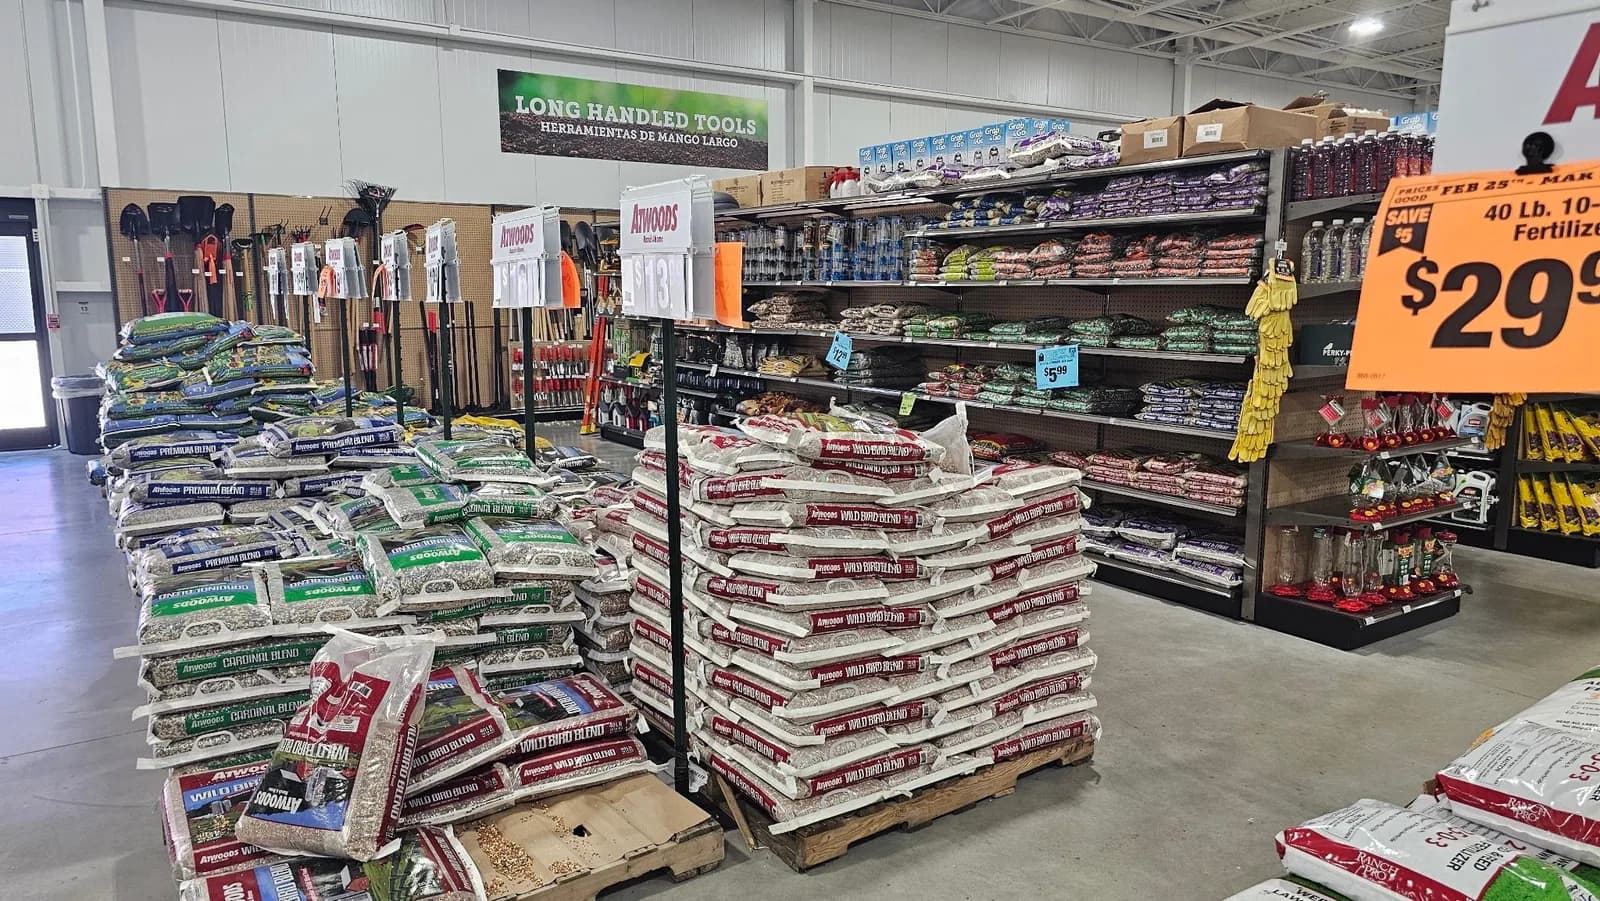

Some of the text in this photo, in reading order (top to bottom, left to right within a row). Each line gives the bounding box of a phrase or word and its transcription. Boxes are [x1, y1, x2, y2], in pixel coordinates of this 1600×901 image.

[515, 95, 756, 135] LONG HANDLED TOOLS
[541, 121, 738, 148] HERRAMIENTAS DE MANGO LARGO
[1399, 185, 1440, 195] PRICES
[1440, 182, 1479, 196] FEB
[1540, 172, 1593, 186] MAR
[1395, 194, 1427, 204] GOOD
[631, 203, 678, 234] ATWOODS
[1385, 207, 1431, 226] SAVE
[1484, 203, 1512, 222] 40
[1519, 201, 1551, 219] Lb.
[500, 223, 534, 248] ATWOODS
[1395, 228, 1413, 244] $5
[354, 434, 374, 445] BLEND
[160, 445, 216, 456] PREMIUM BLEND
[852, 444, 870, 456] WILD
[183, 485, 219, 495] PREMIUM
[221, 485, 245, 495] BLEND
[492, 504, 515, 514] BLEND
[841, 510, 860, 522] WILD
[205, 553, 239, 568] PREMIUM
[239, 551, 260, 562] BLEND
[409, 548, 461, 561] ATWOODS
[844, 562, 862, 573] WILD
[863, 562, 880, 573] BIRD
[305, 585, 360, 596] ATWOODS
[173, 595, 235, 609] ATWOODS
[1015, 601, 1031, 614] WILD
[1046, 592, 1064, 605] BLEND
[846, 614, 866, 625] WILD
[866, 612, 883, 624] BIRD
[507, 633, 529, 642] BLEND
[183, 648, 299, 674] ATWOODS CARDINAL BLEND
[1017, 646, 1033, 659] WILD
[845, 664, 864, 677] WILD
[866, 662, 882, 674] BIRD
[1034, 686, 1049, 699] BIRD
[192, 716, 224, 729] ATWOODS
[231, 706, 276, 722] CARDINAL
[848, 716, 867, 730] WILD
[869, 713, 886, 727] BIRD
[886, 709, 908, 723] BLEND
[294, 740, 313, 755] BIRD
[429, 734, 476, 764] BIRD BLEND
[520, 726, 604, 754] WILD BIRD BLEND
[1020, 738, 1036, 751] WILD
[314, 743, 349, 760] WILD
[554, 757, 575, 770] WILD
[593, 748, 616, 762] BLEND
[757, 740, 774, 760] BLEND
[400, 752, 413, 782] BIRD
[816, 759, 905, 790] ATWOODS WILD BIRD BLEND
[190, 784, 230, 803] WILD
[254, 790, 302, 814] ATWOODS
[391, 783, 405, 820] BLEND
[408, 783, 478, 810] WILD BIRD BLEND
[1507, 797, 1548, 816] RANCH
[1514, 808, 1540, 822] PRO
[200, 848, 239, 864] ATWOODS
[1357, 852, 1398, 878] RANCH
[1447, 840, 1493, 872] FERTILIZER
[1362, 864, 1388, 882] PRO
